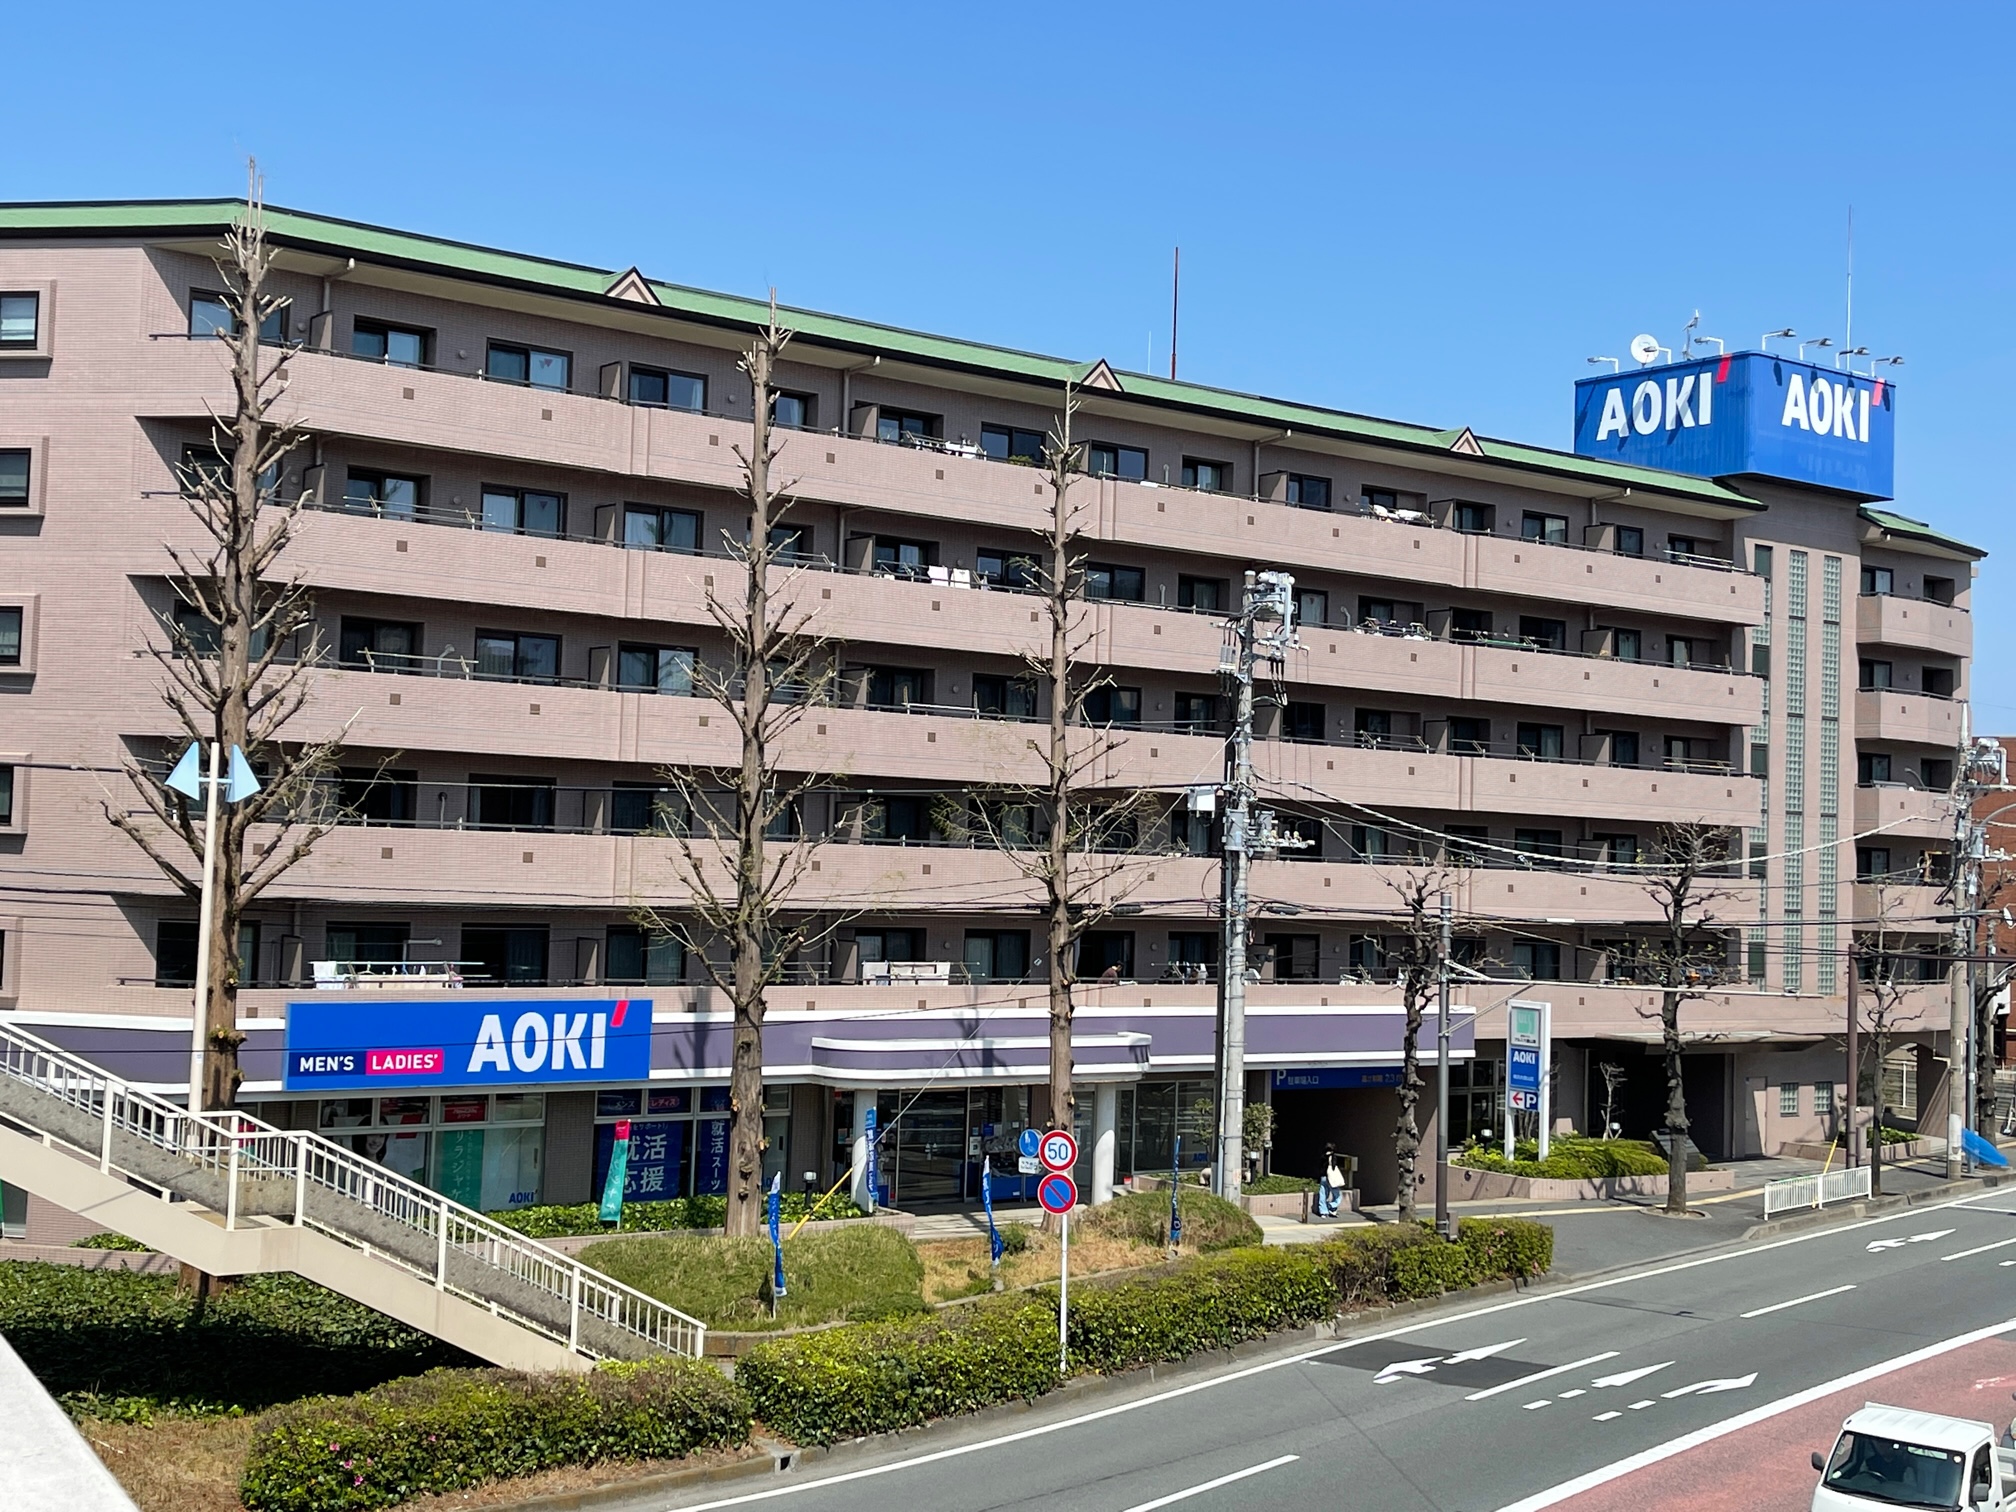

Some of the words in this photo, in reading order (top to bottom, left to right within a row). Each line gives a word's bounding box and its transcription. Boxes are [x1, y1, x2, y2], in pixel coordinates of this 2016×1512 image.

[1596, 372, 1712, 441] AOKI
[1782, 373, 1870, 443] AOKI
[467, 1012, 607, 1073] AOKI
[299, 1055, 355, 1073] MEN'S
[372, 1053, 439, 1071] LADIES'
[1513, 1050, 1536, 1065] AOKI
[1277, 1069, 1287, 1086] P
[1526, 1094, 1537, 1108] P
[1047, 1142, 1069, 1161] 50
[508, 1191, 534, 1204] AOKI
